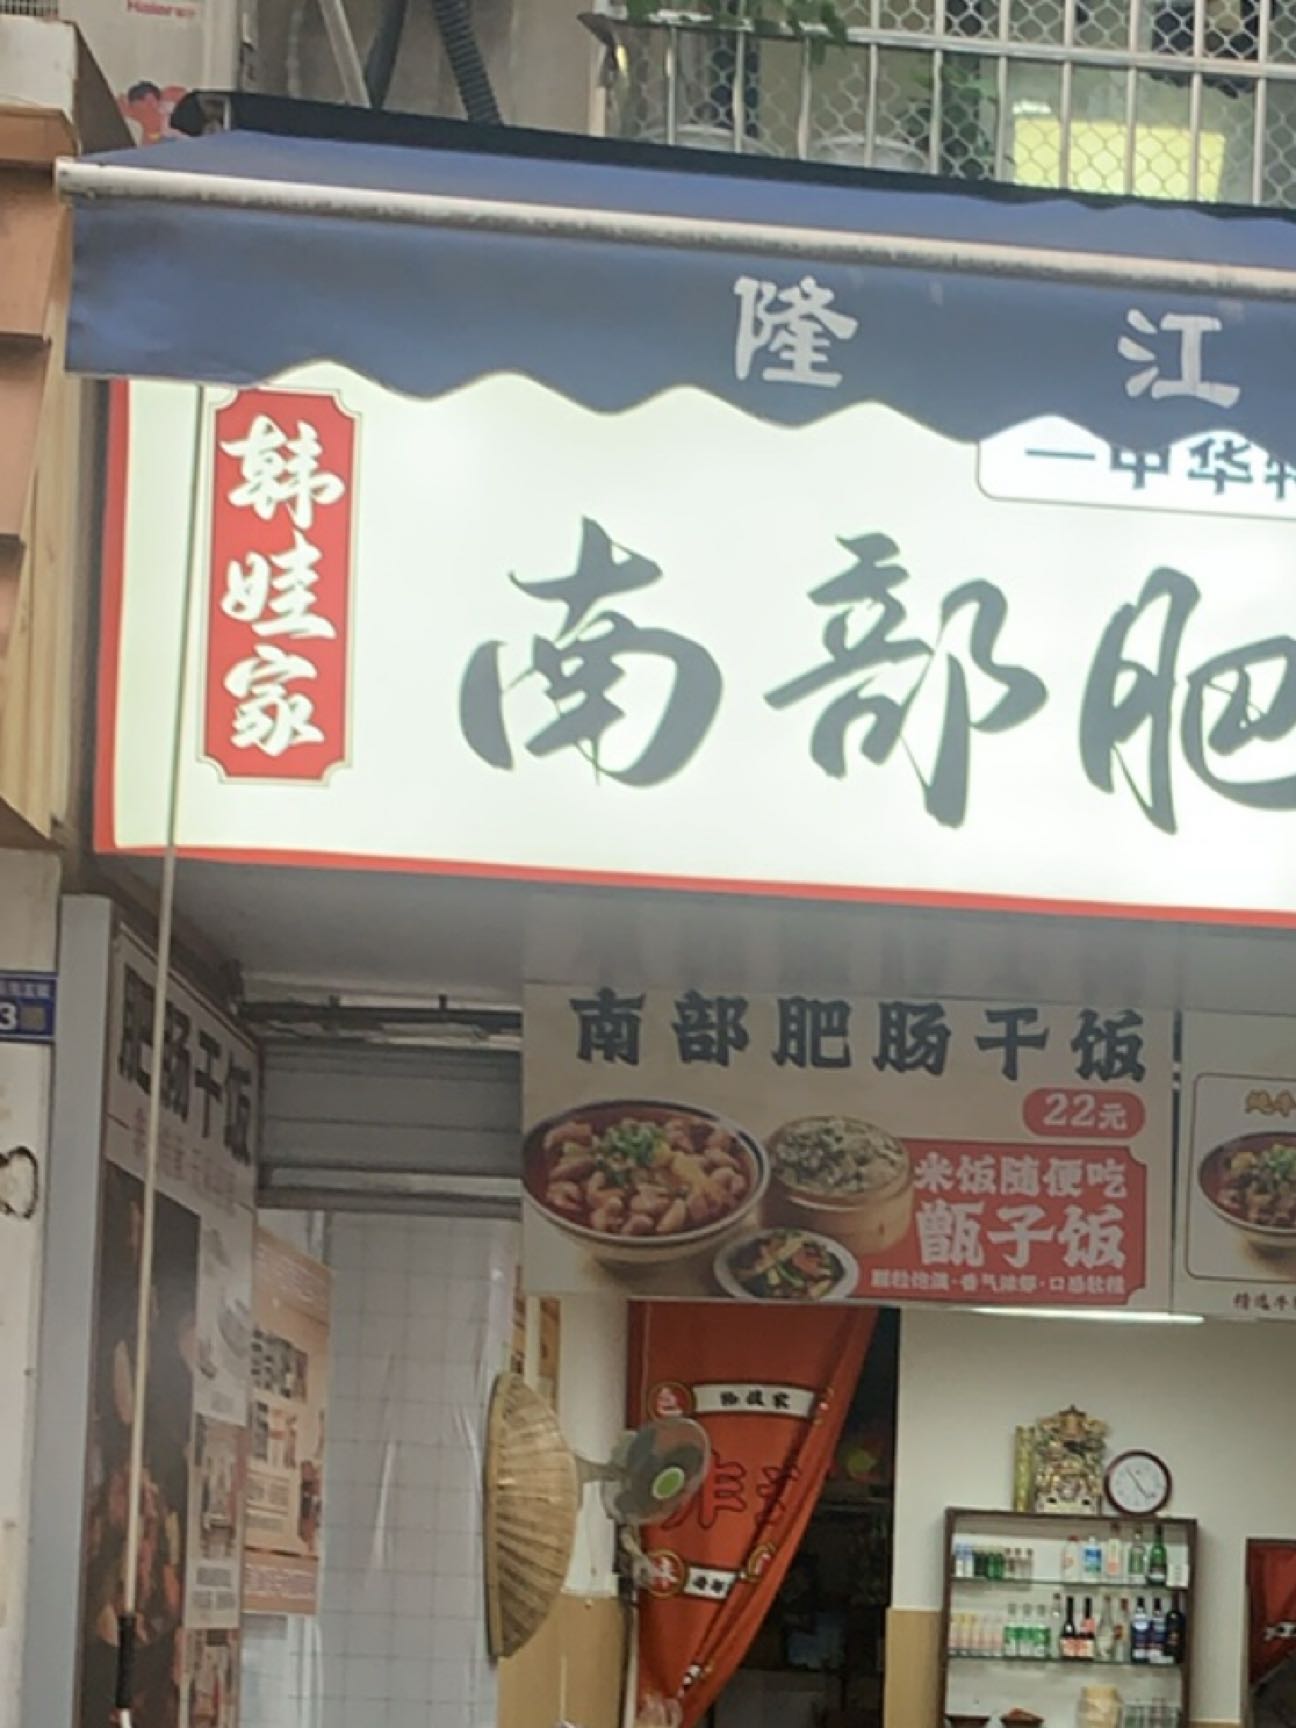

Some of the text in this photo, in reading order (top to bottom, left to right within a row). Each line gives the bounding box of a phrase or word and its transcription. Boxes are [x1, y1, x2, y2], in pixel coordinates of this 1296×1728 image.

[218, 413, 347, 758] 韩娃家
[568, 986, 1148, 1084] 南部肥肠干饭
[1042, 1092, 1128, 1131] 22元
[913, 1150, 1128, 1198] 米饭随便吃
[914, 1197, 1127, 1270] 甑子饭
